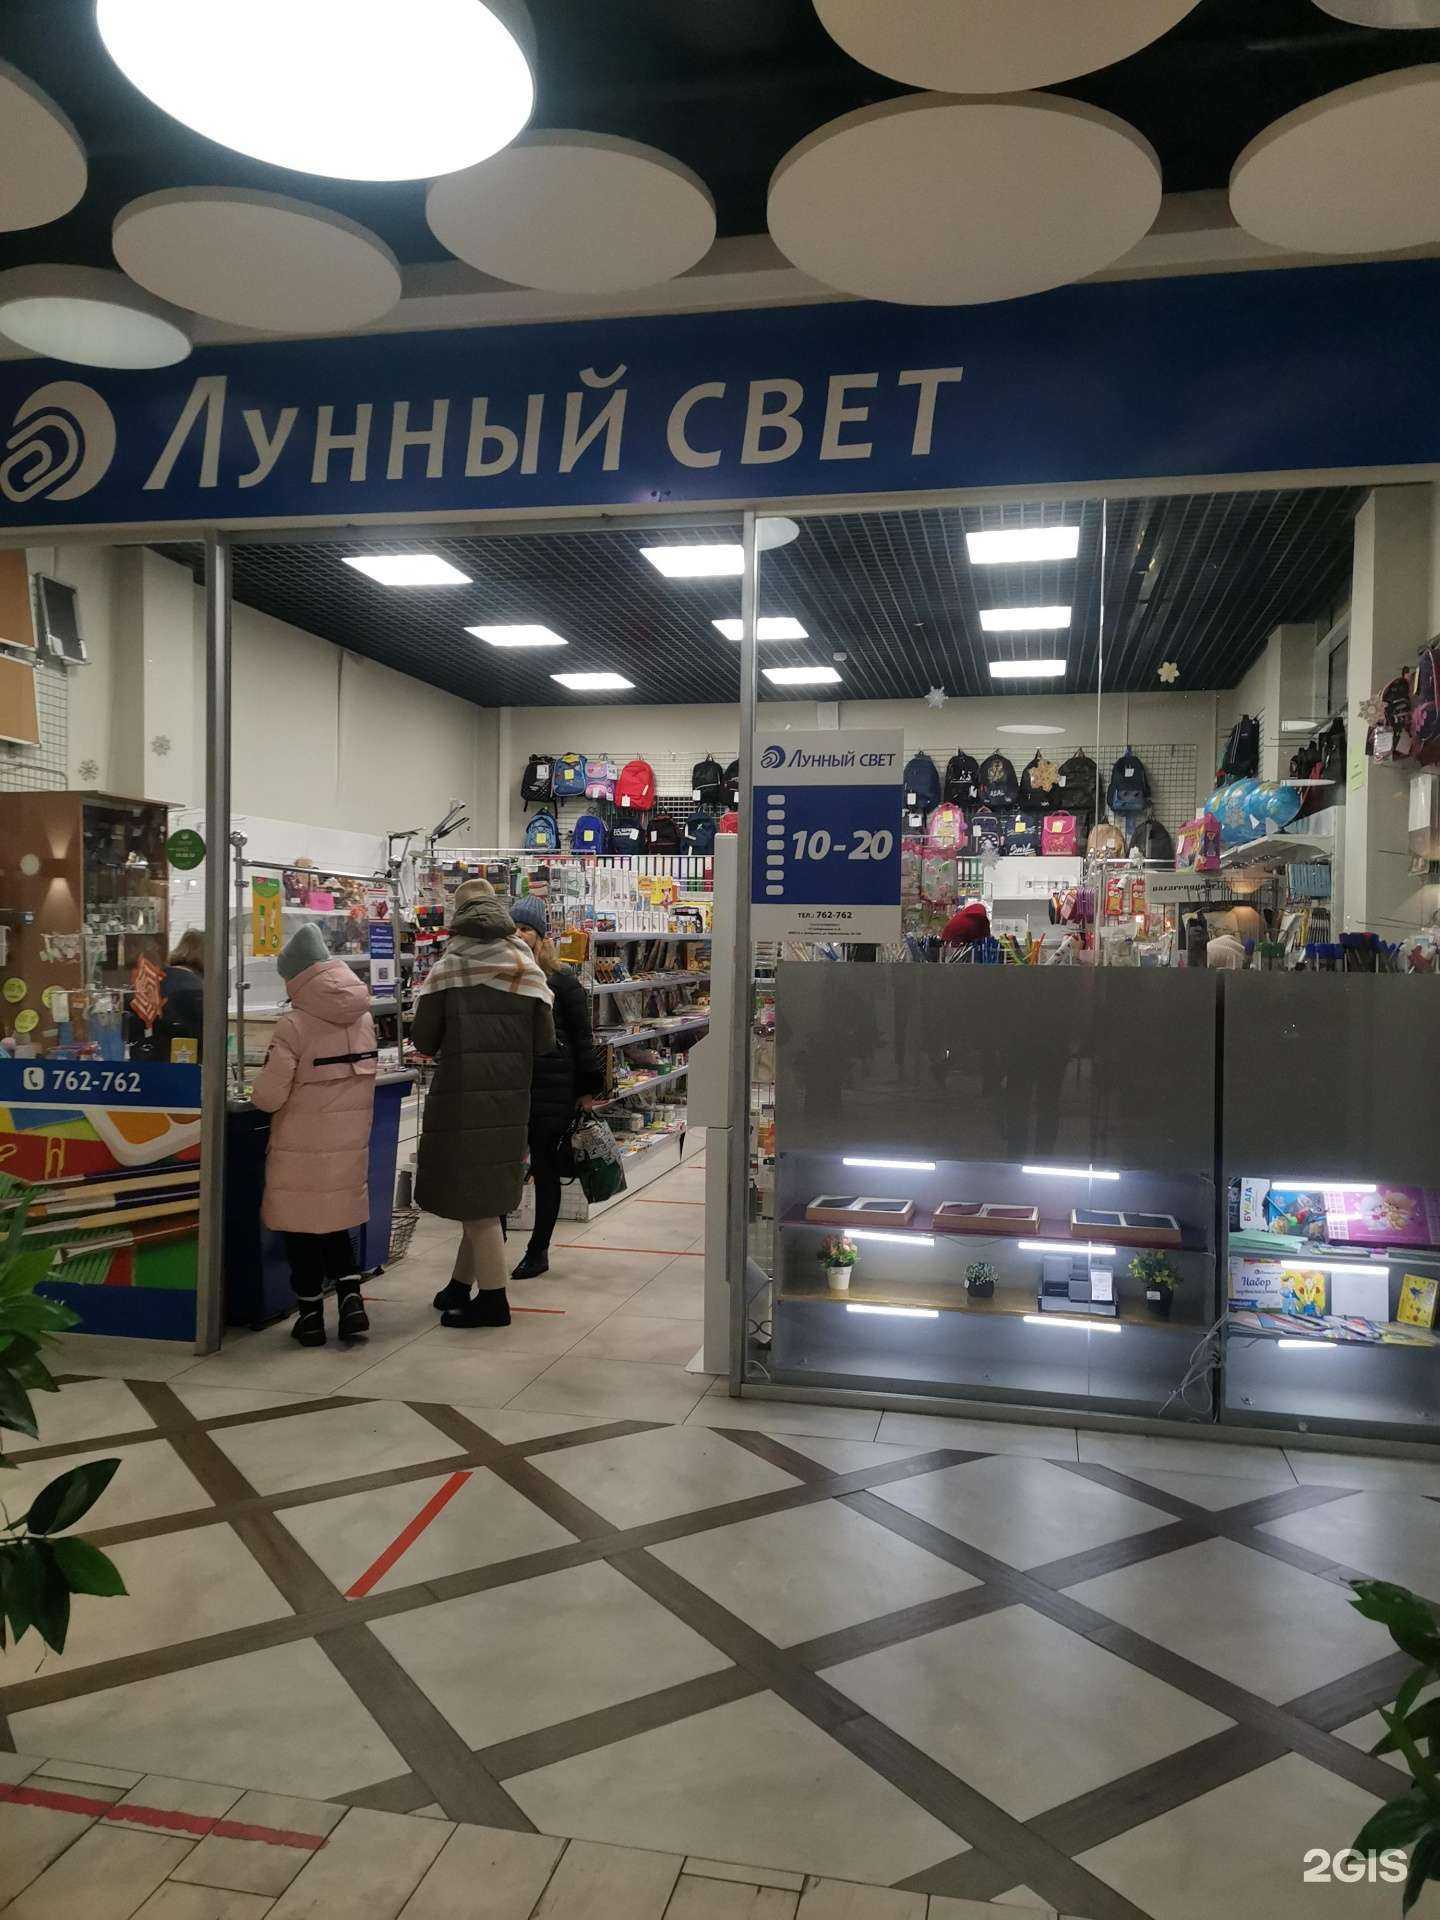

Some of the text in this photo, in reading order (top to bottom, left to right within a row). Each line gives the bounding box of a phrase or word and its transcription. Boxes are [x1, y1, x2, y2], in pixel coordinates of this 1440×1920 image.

[666, 366, 964, 468] СВЕТ
[859, 753, 896, 767] СВЕТ
[792, 830, 893, 861] 10-20
[816, 911, 853, 919] 762-762
[52, 1069, 142, 1093] 762-762
